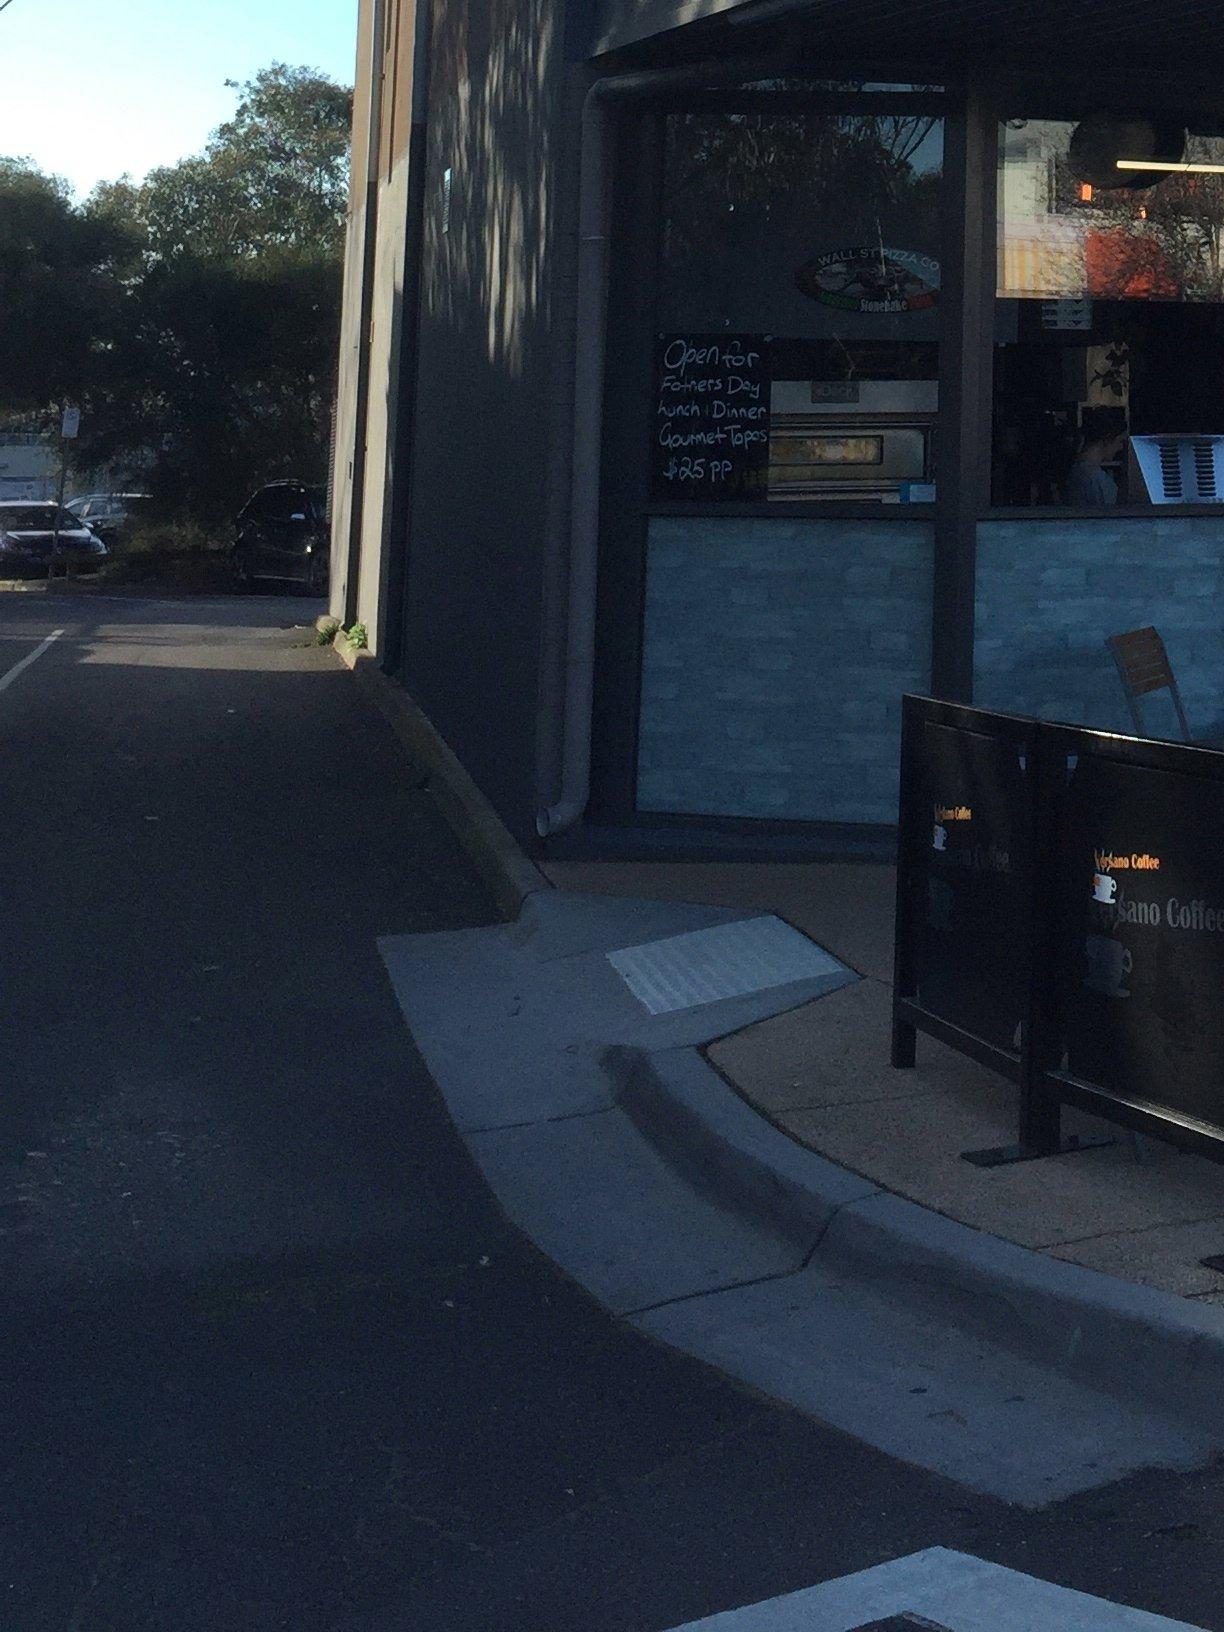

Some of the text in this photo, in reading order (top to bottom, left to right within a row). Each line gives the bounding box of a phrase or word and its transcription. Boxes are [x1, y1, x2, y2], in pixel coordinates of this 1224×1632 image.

[818, 249, 856, 267] WALL
[860, 247, 878, 259] ST
[920, 255, 940, 270] CO
[664, 339, 760, 376] Open for
[727, 375, 760, 399] Day
[711, 400, 767, 420] Dinner
[658, 422, 727, 449] Gourmet
[662, 456, 705, 482] $25
[1131, 853, 1160, 870] Coffee
